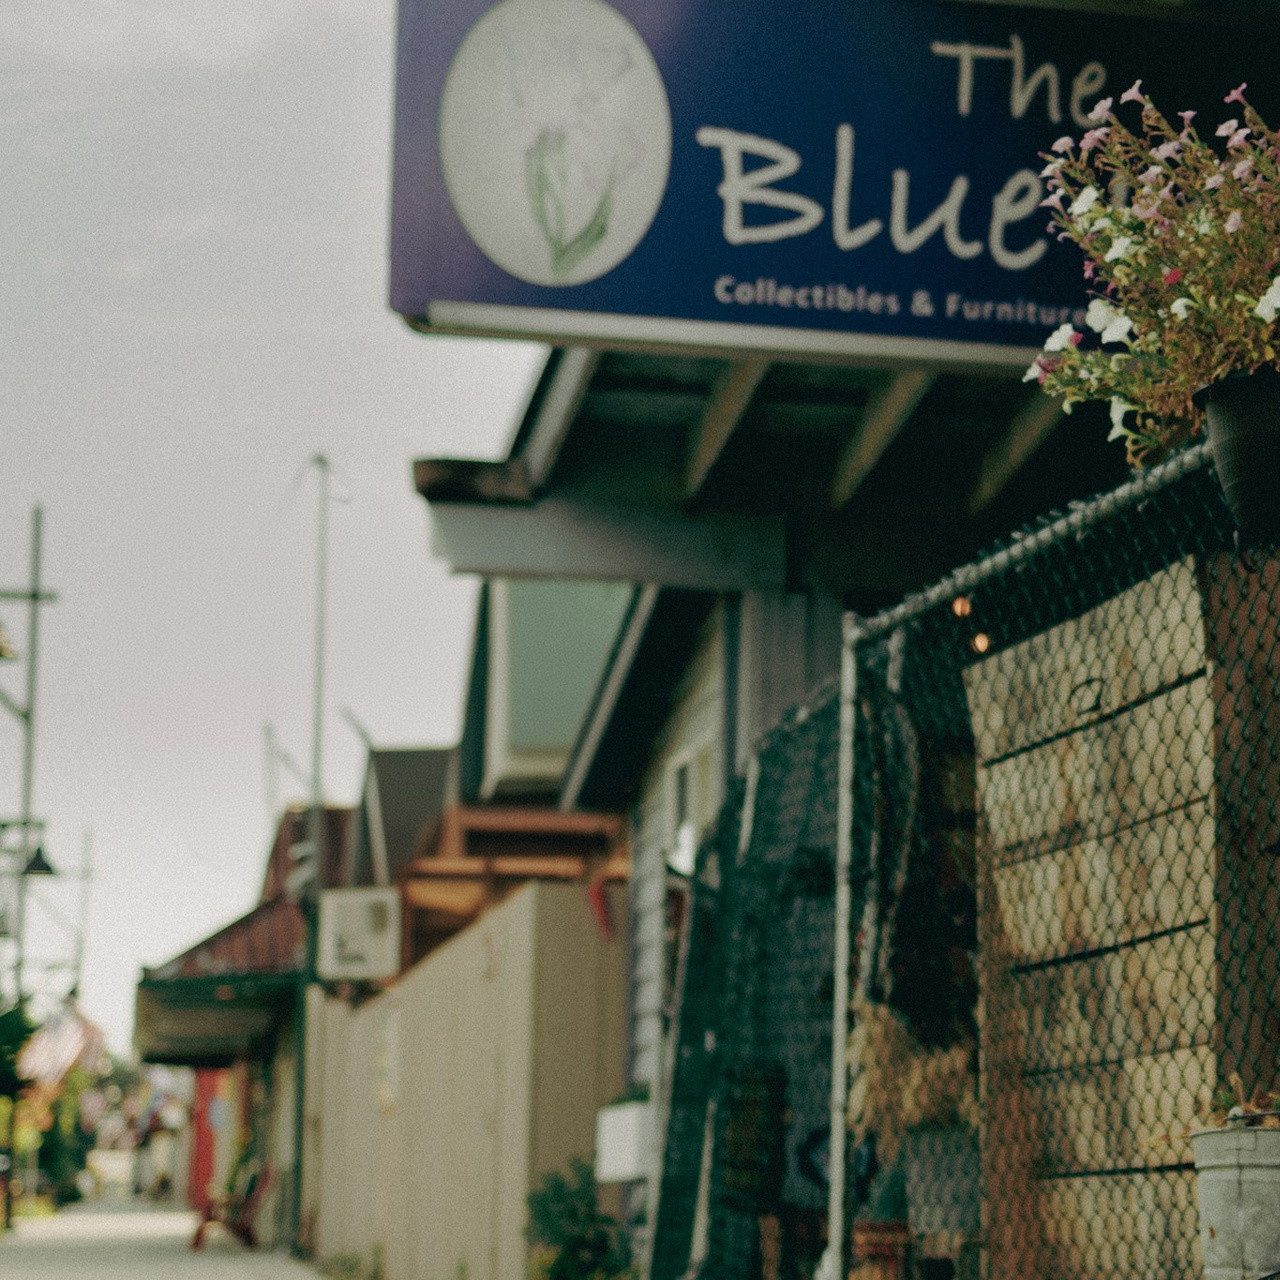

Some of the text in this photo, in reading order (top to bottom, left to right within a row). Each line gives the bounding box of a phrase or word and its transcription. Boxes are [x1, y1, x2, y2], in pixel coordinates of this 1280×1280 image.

[931, 33, 1106, 128] The
[696, 123, 1048, 270] Blue
[713, 275, 1088, 326] Collectibles & Furniture
